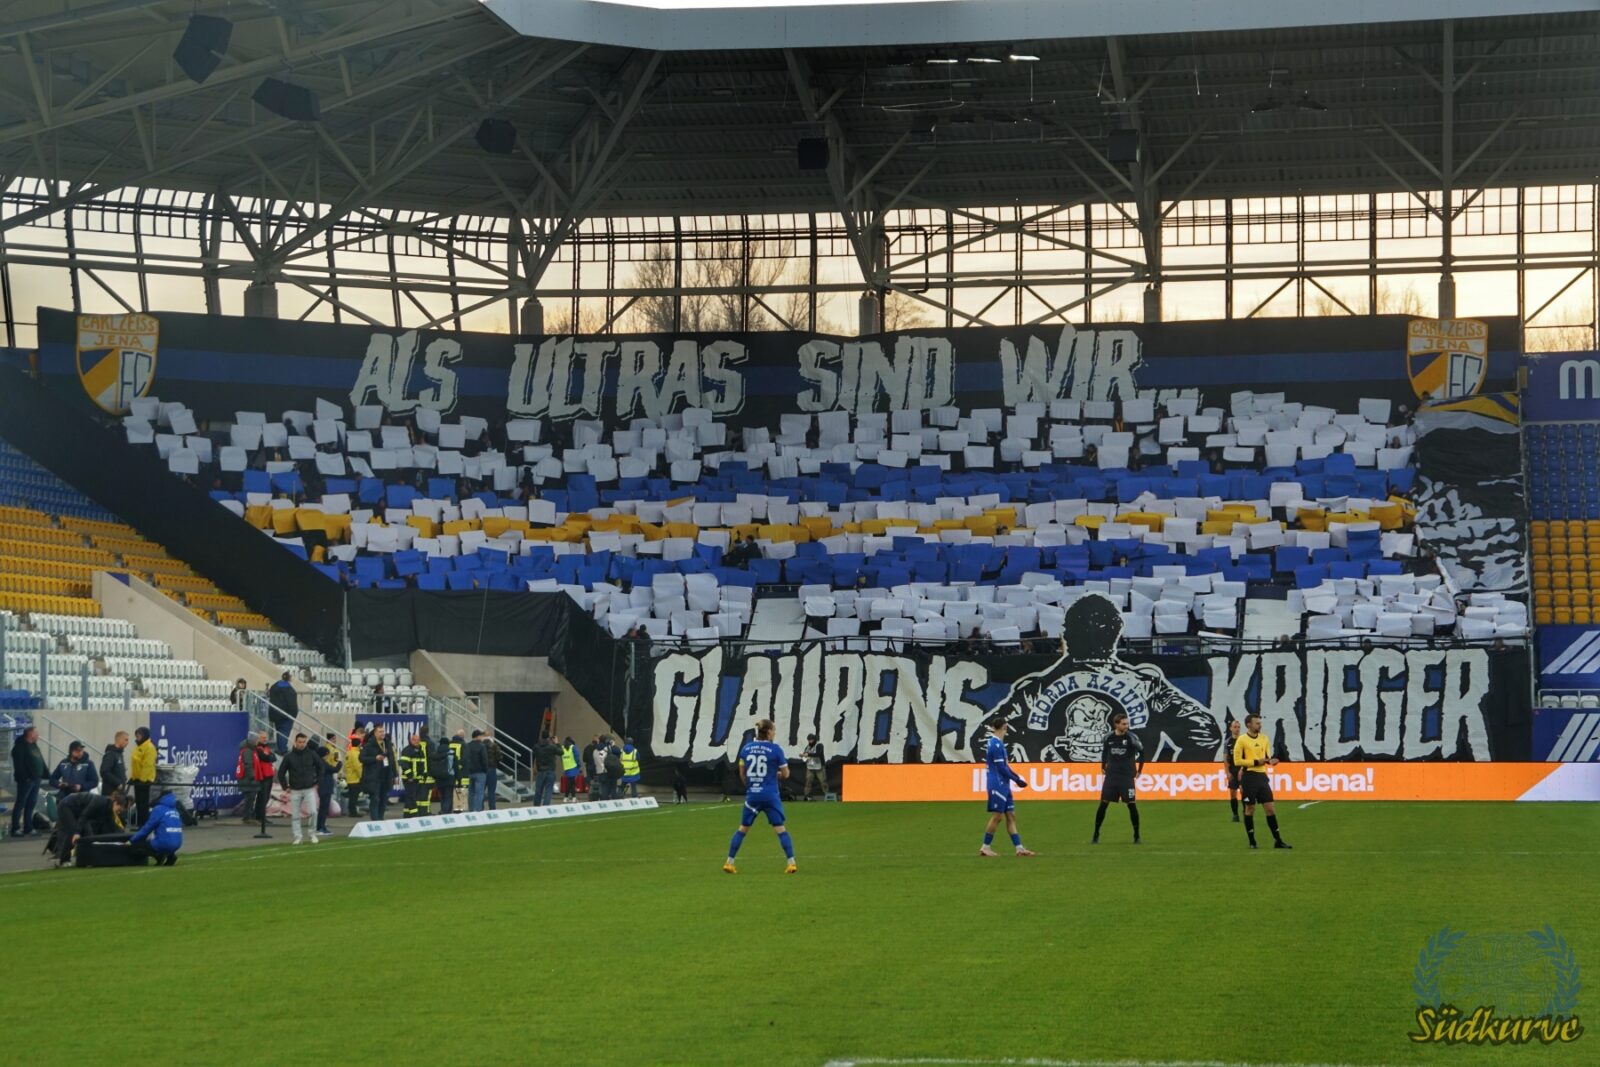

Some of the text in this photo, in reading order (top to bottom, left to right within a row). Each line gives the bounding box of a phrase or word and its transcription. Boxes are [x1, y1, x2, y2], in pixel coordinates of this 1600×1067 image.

[95, 334, 143, 346] JENA
[120, 315, 155, 332] ZEISS
[1424, 340, 1470, 351] JENA
[121, 351, 152, 408] FC
[350, 330, 464, 417] ALS
[506, 336, 749, 421] ULTRAS
[796, 335, 956, 414] SIND
[1449, 354, 1484, 399] FC
[650, 645, 1493, 764] GLAUBENS KRIEGER
[1029, 674, 1148, 729] HORDA AZZURO
[746, 754, 768, 777] 26
[1295, 767, 1375, 793] Jena!
